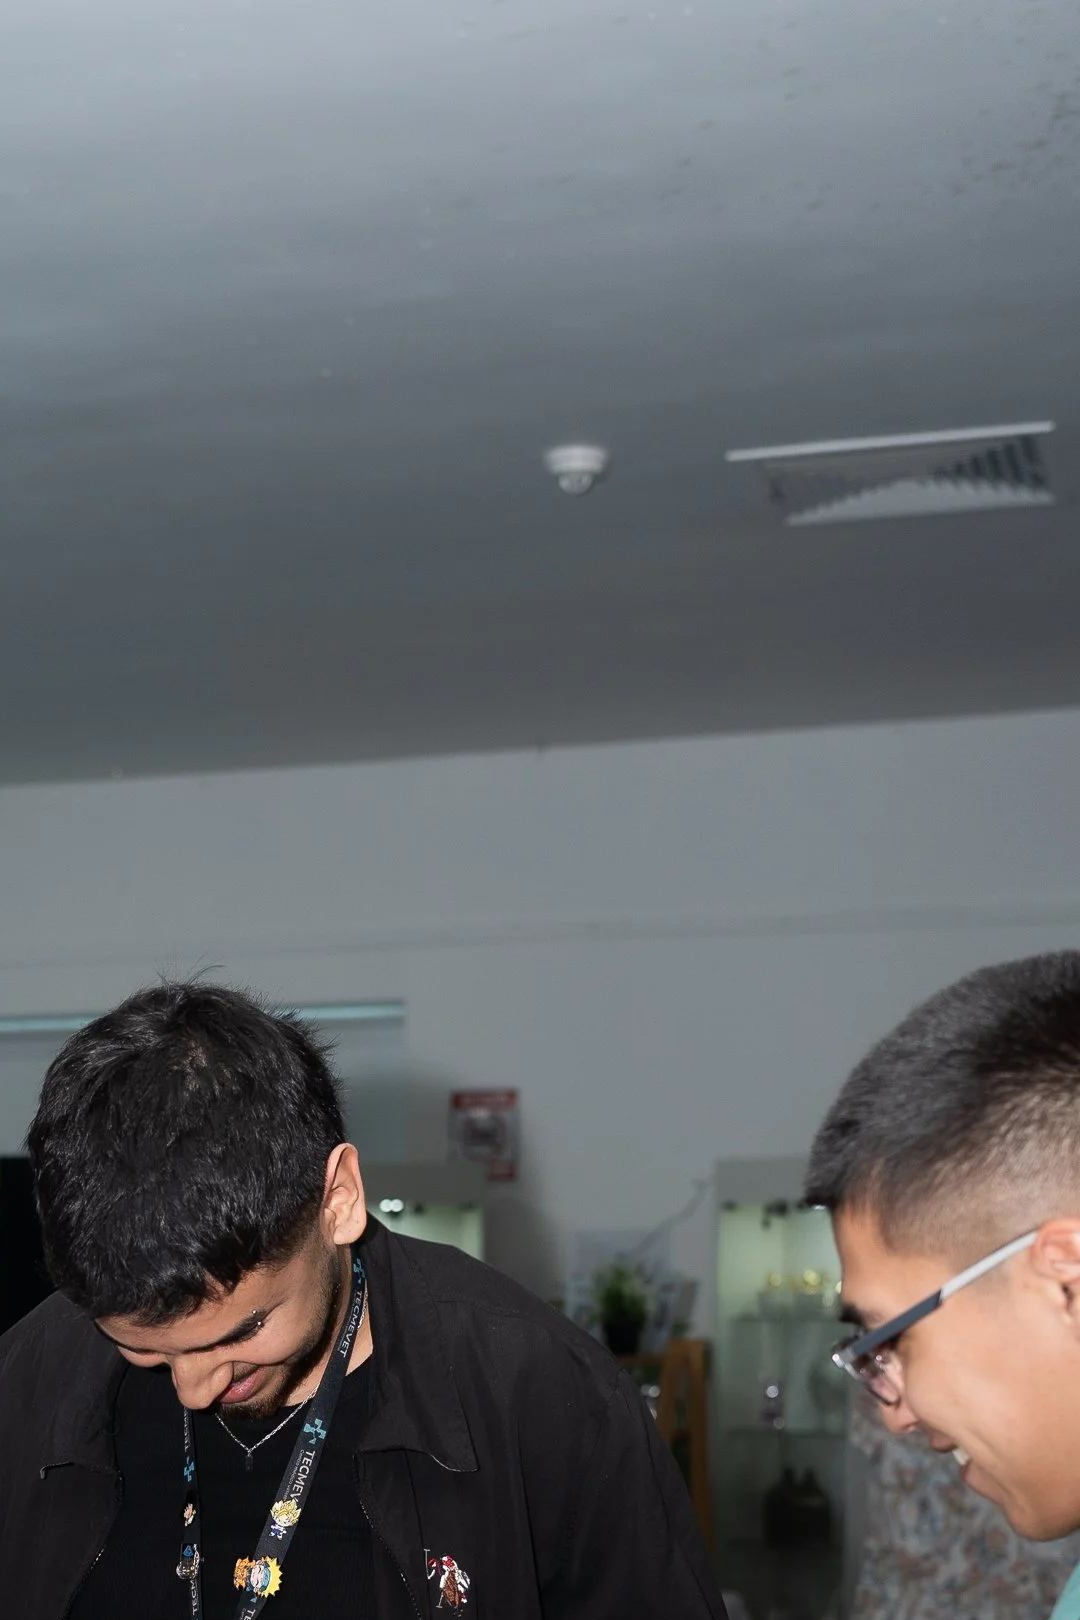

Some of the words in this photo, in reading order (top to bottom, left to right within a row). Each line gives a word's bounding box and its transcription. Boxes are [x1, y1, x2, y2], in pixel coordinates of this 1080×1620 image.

[340, 1290, 363, 1358] TECMEVET
[289, 1450, 316, 1503] TECMEV
[190, 1580, 198, 1616] TECM
